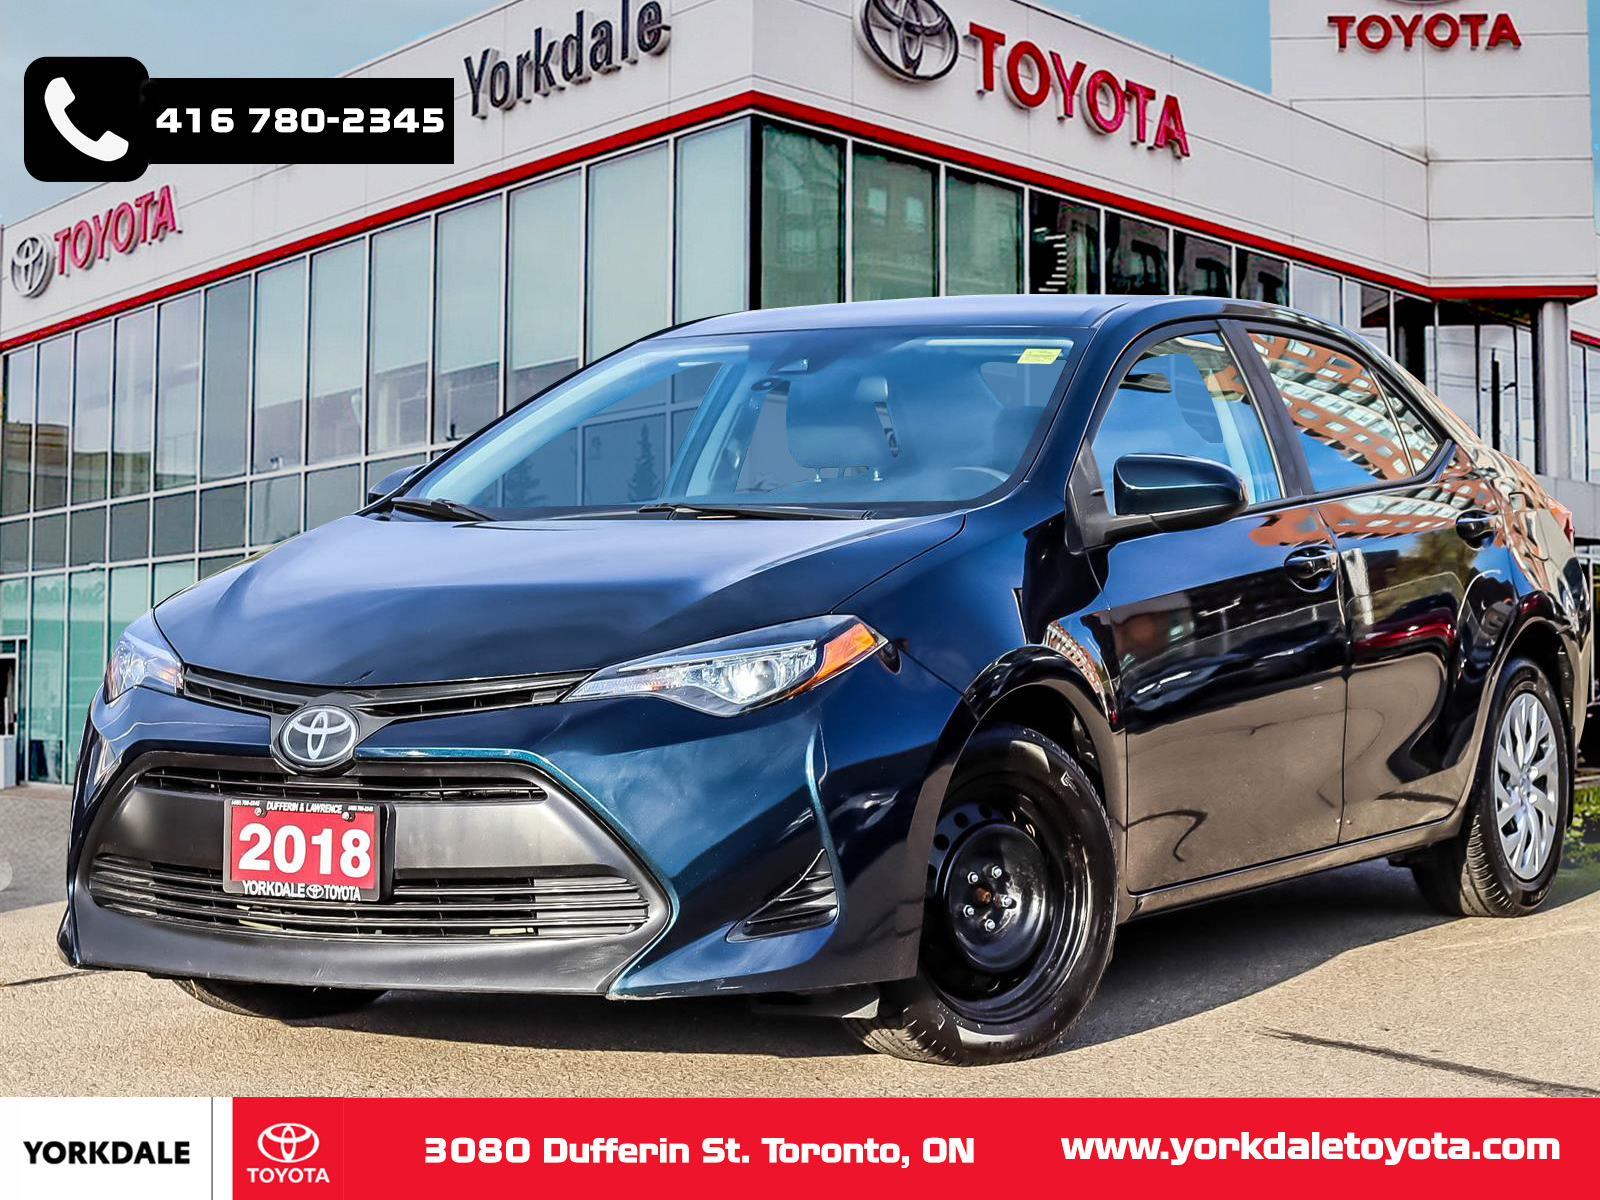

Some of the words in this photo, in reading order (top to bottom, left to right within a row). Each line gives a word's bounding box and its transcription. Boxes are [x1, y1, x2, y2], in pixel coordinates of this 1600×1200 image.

[463, 0, 671, 118] Yorkdale
[1328, 13, 1522, 50] TOYOTA
[967, 22, 1192, 158] TOYOTA
[54, 185, 180, 275] TOYOTA
[266, 801, 299, 812] DUFFERIN
[305, 803, 343, 814] LAWRENCE
[238, 822, 371, 879] 2018
[242, 880, 306, 898] YORKDALE
[324, 885, 361, 902] TOYOTA
